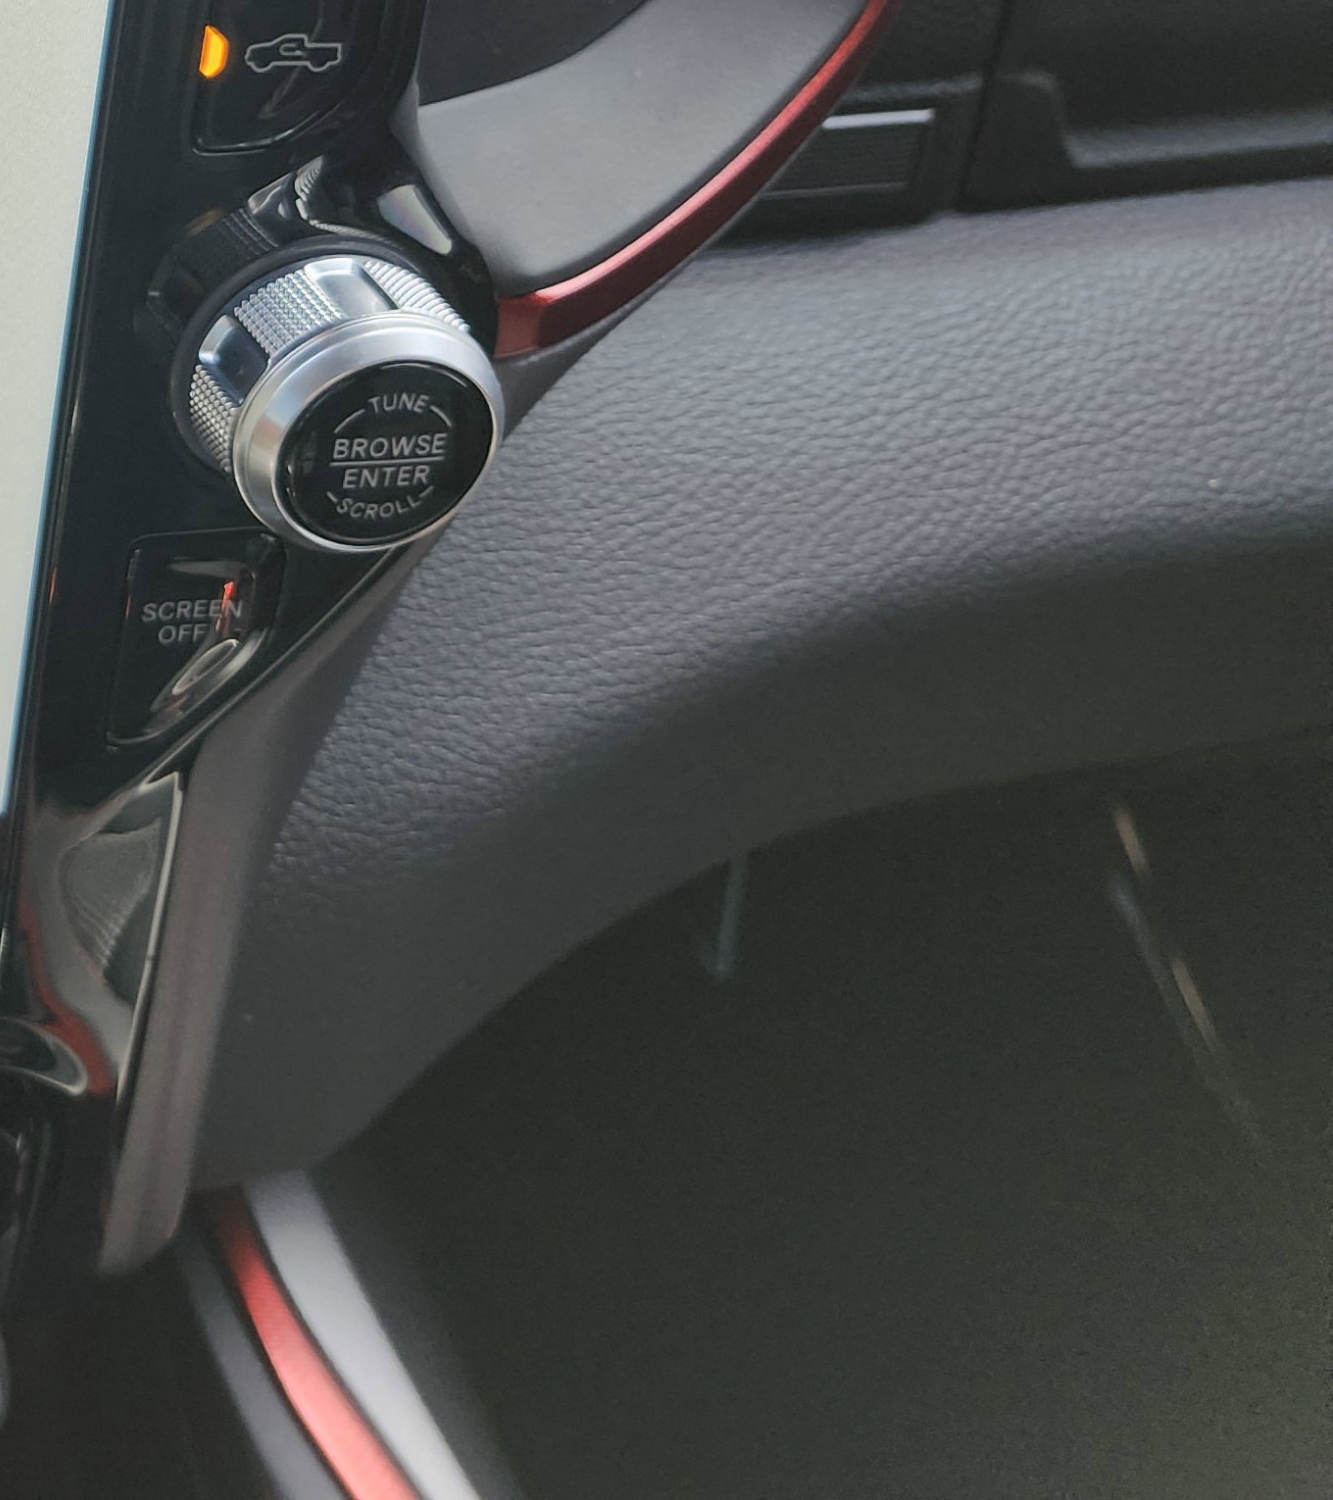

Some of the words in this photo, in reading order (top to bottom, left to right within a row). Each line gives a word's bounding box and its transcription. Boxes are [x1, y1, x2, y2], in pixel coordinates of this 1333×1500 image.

[368, 392, 430, 415] TUNE
[333, 433, 448, 459] BROWSE
[342, 465, 431, 489] ENTER
[336, 495, 421, 520] SCROLL
[141, 600, 243, 622] SCREEN
[158, 624, 210, 645] OFF
